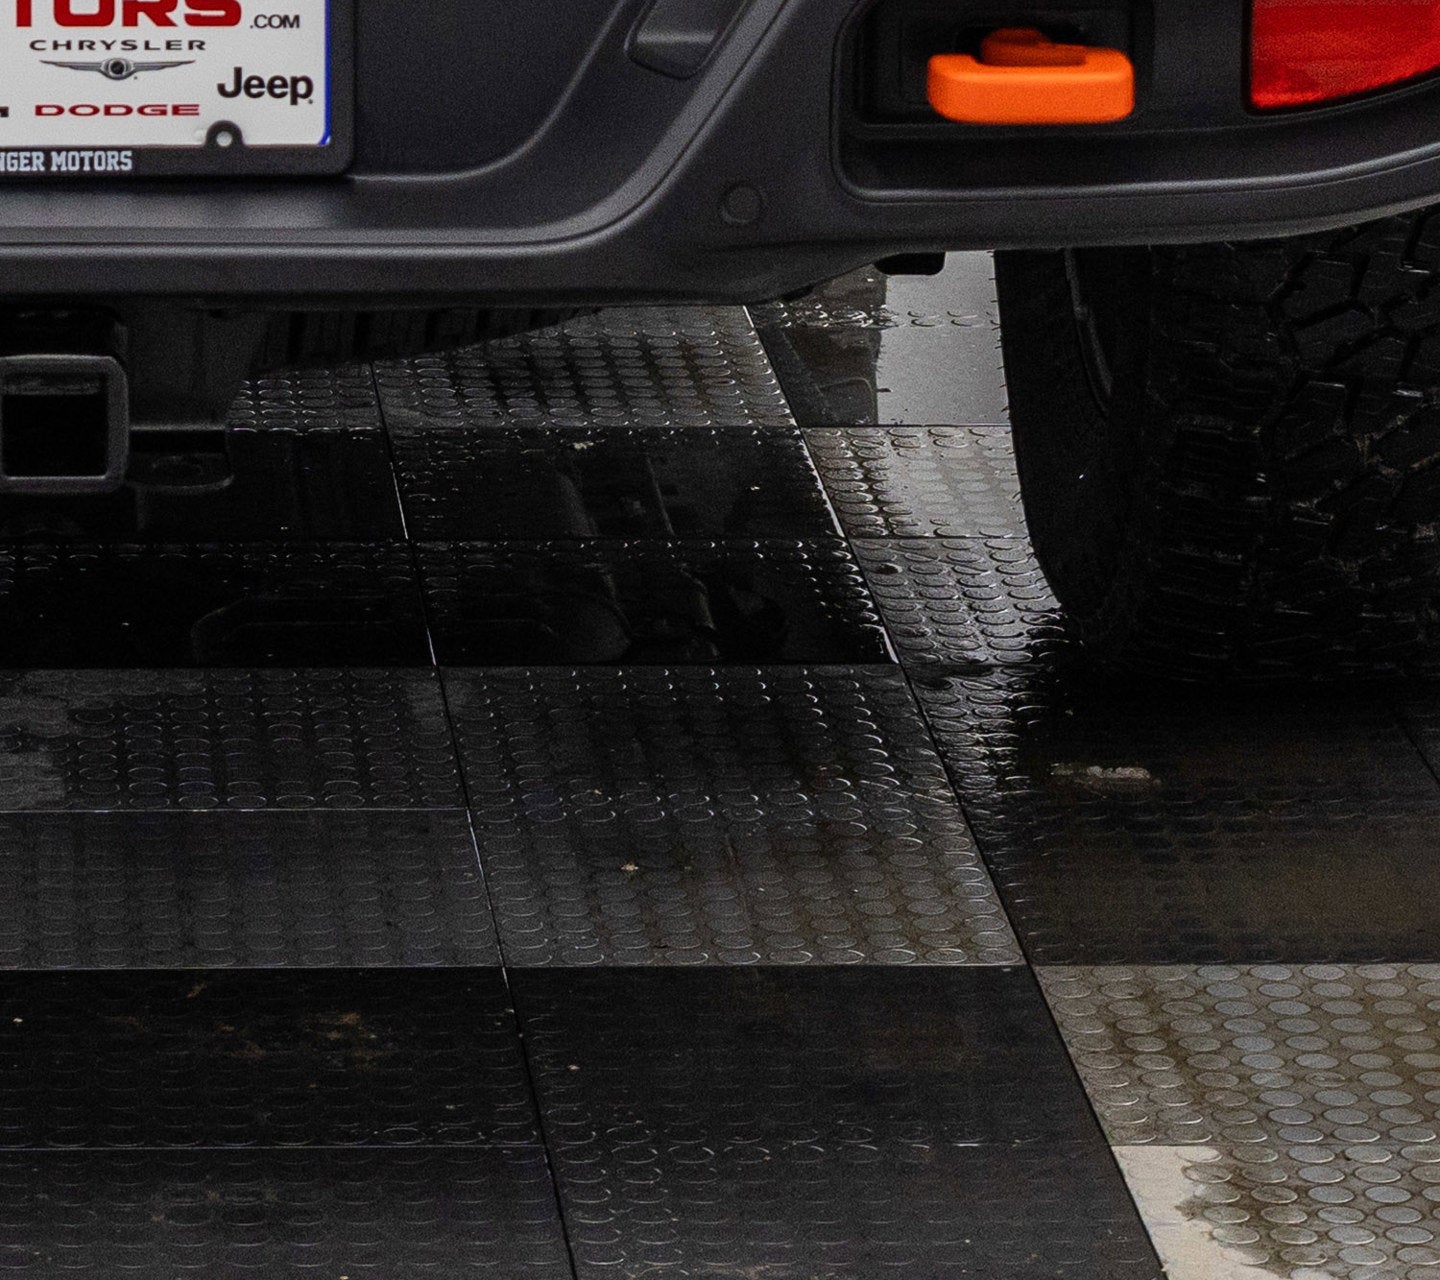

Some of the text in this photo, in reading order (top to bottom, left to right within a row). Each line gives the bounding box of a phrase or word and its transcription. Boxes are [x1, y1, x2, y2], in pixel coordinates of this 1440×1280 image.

[250, 14, 300, 29] .COM
[29, 40, 206, 50] CHRYSLER
[216, 66, 313, 104] Jeep
[35, 104, 200, 116] DODGE
[51, 151, 132, 172] MOTORS
